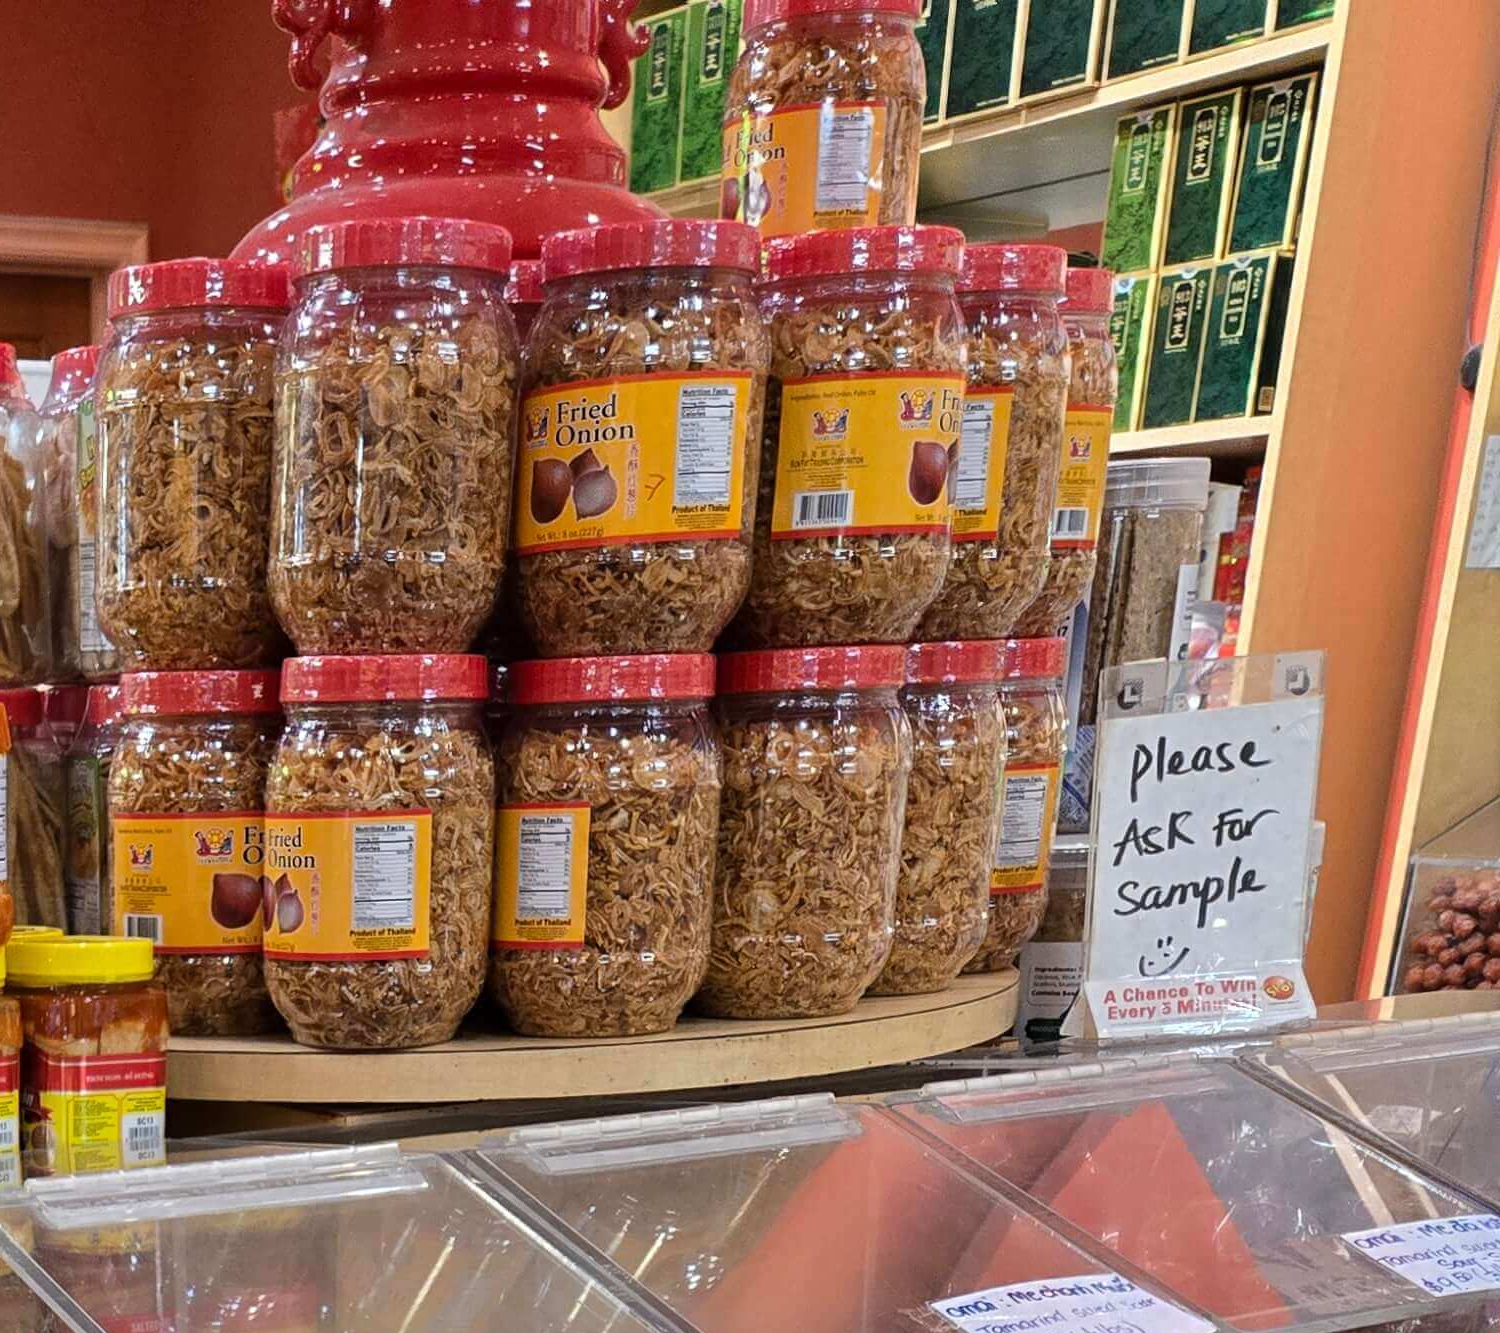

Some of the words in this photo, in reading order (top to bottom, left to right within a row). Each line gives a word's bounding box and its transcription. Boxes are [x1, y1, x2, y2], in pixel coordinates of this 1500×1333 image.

[557, 393, 618, 425] Fried
[555, 421, 635, 448] Onion
[267, 825, 303, 849] Fried
[269, 847, 316, 869] Onion
[350, 927, 376, 937] Product
[386, 926, 417, 936] Thailand
[1103, 989, 1117, 1005] A
[1122, 985, 1189, 1003] Chance
[1194, 981, 1215, 997] To
[1219, 978, 1257, 994] Win
[1106, 1003, 1157, 1022] Every
